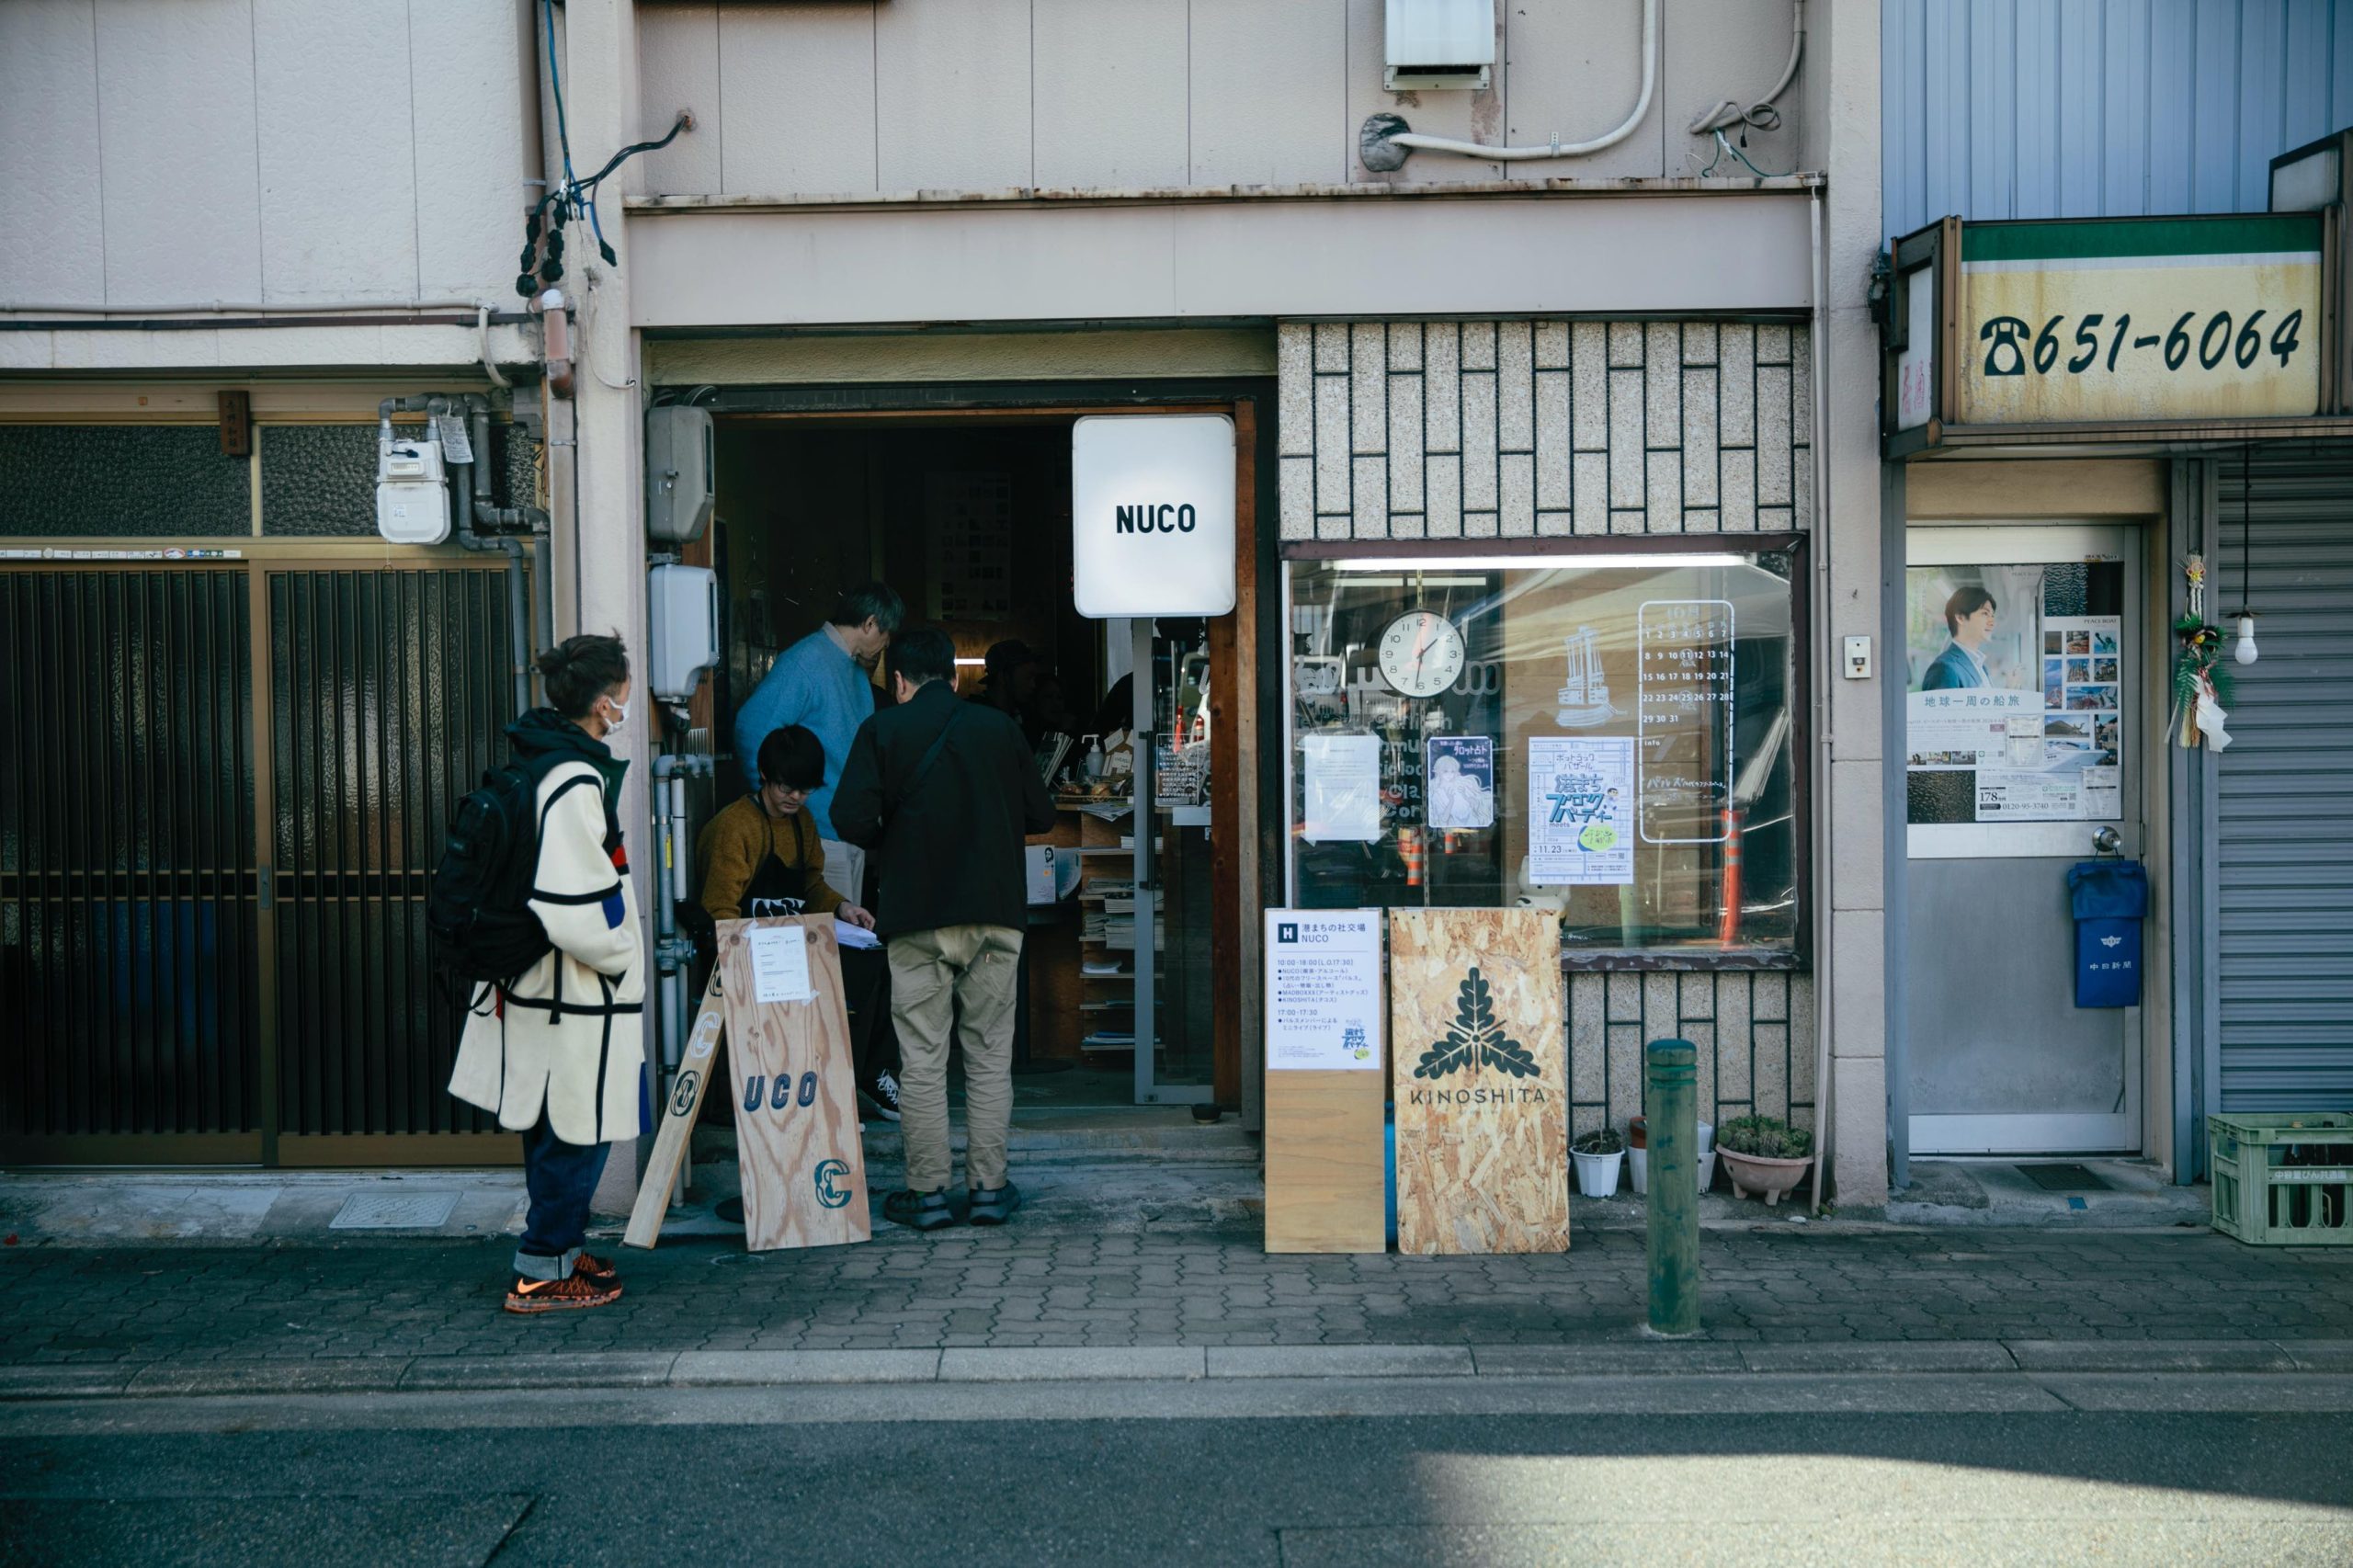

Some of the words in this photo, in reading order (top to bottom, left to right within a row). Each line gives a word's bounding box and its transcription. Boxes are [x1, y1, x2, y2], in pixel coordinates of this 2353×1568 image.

[2033, 309, 2302, 374] 651-6064
[1116, 504, 1196, 533] NUCO
[1646, 631, 1650, 639] 1
[1658, 631, 1662, 639] 2
[1671, 631, 1675, 639] 3
[1684, 631, 1688, 639] 4
[1696, 631, 1700, 639] 5
[1709, 631, 1713, 639] 6
[1722, 631, 1726, 639] 7
[1645, 651, 1651, 660] 8
[1658, 651, 1663, 660] 9
[1669, 651, 1677, 660] 10
[1682, 651, 1690, 660] 11
[1708, 650, 1715, 658] 13
[1720, 650, 1728, 658] 14
[1402, 677, 1408, 686] 7
[1643, 693, 1653, 701] 22
[1656, 693, 1665, 701] 23
[1669, 693, 1678, 701] 24
[1682, 693, 1691, 701] 25
[1707, 692, 1716, 700] 27
[1720, 692, 1729, 700] 28
[1925, 695, 2020, 707] 地球一周の船旅
[1555, 773, 1604, 793] 港まち
[1283, 927, 1292, 939] H
[1302, 923, 1366, 932] 港まちの社交場
[1302, 935, 1329, 943] NUCO
[2089, 960, 2131, 971] 中日新聞
[744, 1071, 818, 1113] UCO
[1410, 1088, 1546, 1105] KINOSHITA
[814, 1159, 853, 1209] C
